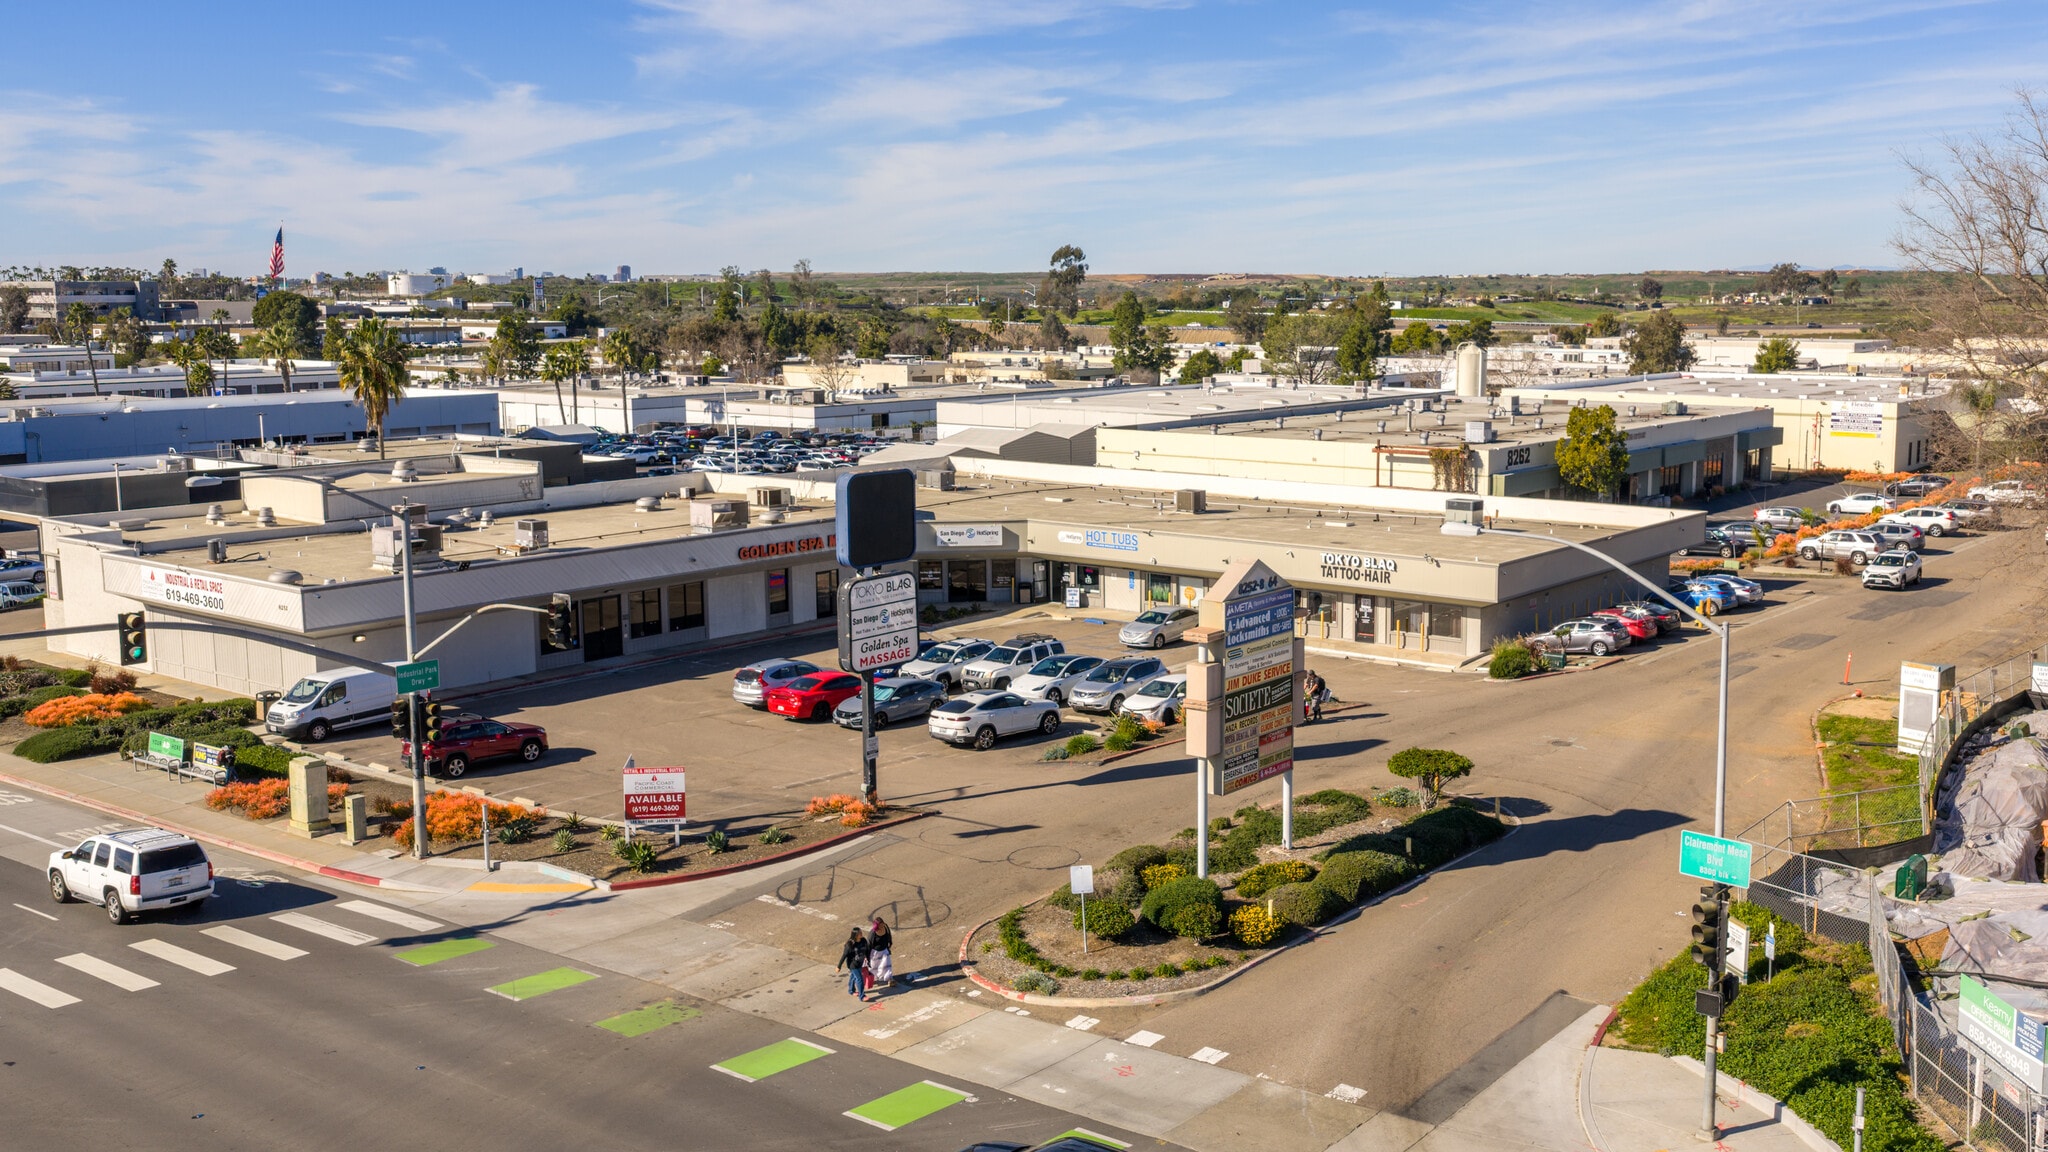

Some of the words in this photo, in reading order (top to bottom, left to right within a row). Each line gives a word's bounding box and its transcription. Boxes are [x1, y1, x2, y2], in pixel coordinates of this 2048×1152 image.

[1507, 447, 1531, 466] 8262
[1085, 530, 1107, 542] HOT
[1111, 532, 1138, 546] TUBS
[739, 541, 796, 560] GOLDEN
[799, 536, 824, 551] SPA
[1320, 553, 1361, 567] TOKYO
[1363, 557, 1397, 572] BLAQ
[165, 573, 189, 588] INDUSTRIAL
[194, 578, 208, 591] RETAIL
[209, 580, 223, 594] SPACE
[854, 583, 884, 598] TOKYO
[886, 577, 911, 593] BLAQ
[165, 588, 224, 610] 619-469-3600
[1234, 601, 1253, 613] META
[863, 615, 878, 623] Diego
[891, 608, 913, 617] HotSpring
[861, 639, 890, 654] Golden
[893, 635, 909, 648] Spa
[1227, 625, 1269, 646] Locksmiths
[1247, 641, 1271, 654] Commercial
[1272, 637, 1289, 647] Connect
[859, 647, 911, 668] MASSAGE
[398, 668, 424, 678] Industrial
[1226, 677, 1239, 691] JIM
[1242, 671, 1261, 687] DUKE
[1264, 662, 1290, 680] SERVICE
[1225, 686, 1271, 719] SOCIETE
[1239, 715, 1258, 729] RECORDS
[1235, 772, 1258, 788] COMICS
[628, 794, 683, 804] AVAILABLE
[632, 805, 648, 813] (619)
[649, 804, 679, 812] 469-3600
[1684, 835, 1725, 854] Clairemont
[1727, 844, 1748, 858] Mesa
[1706, 853, 1723, 867] Blvd
[1718, 870, 1729, 879] blk
[1983, 995, 2012, 1025] Kearny
[1970, 1004, 1993, 1029] OFFICE
[1993, 1020, 2011, 1042] PARK
[1968, 1023, 2030, 1076] 858-292-9948
